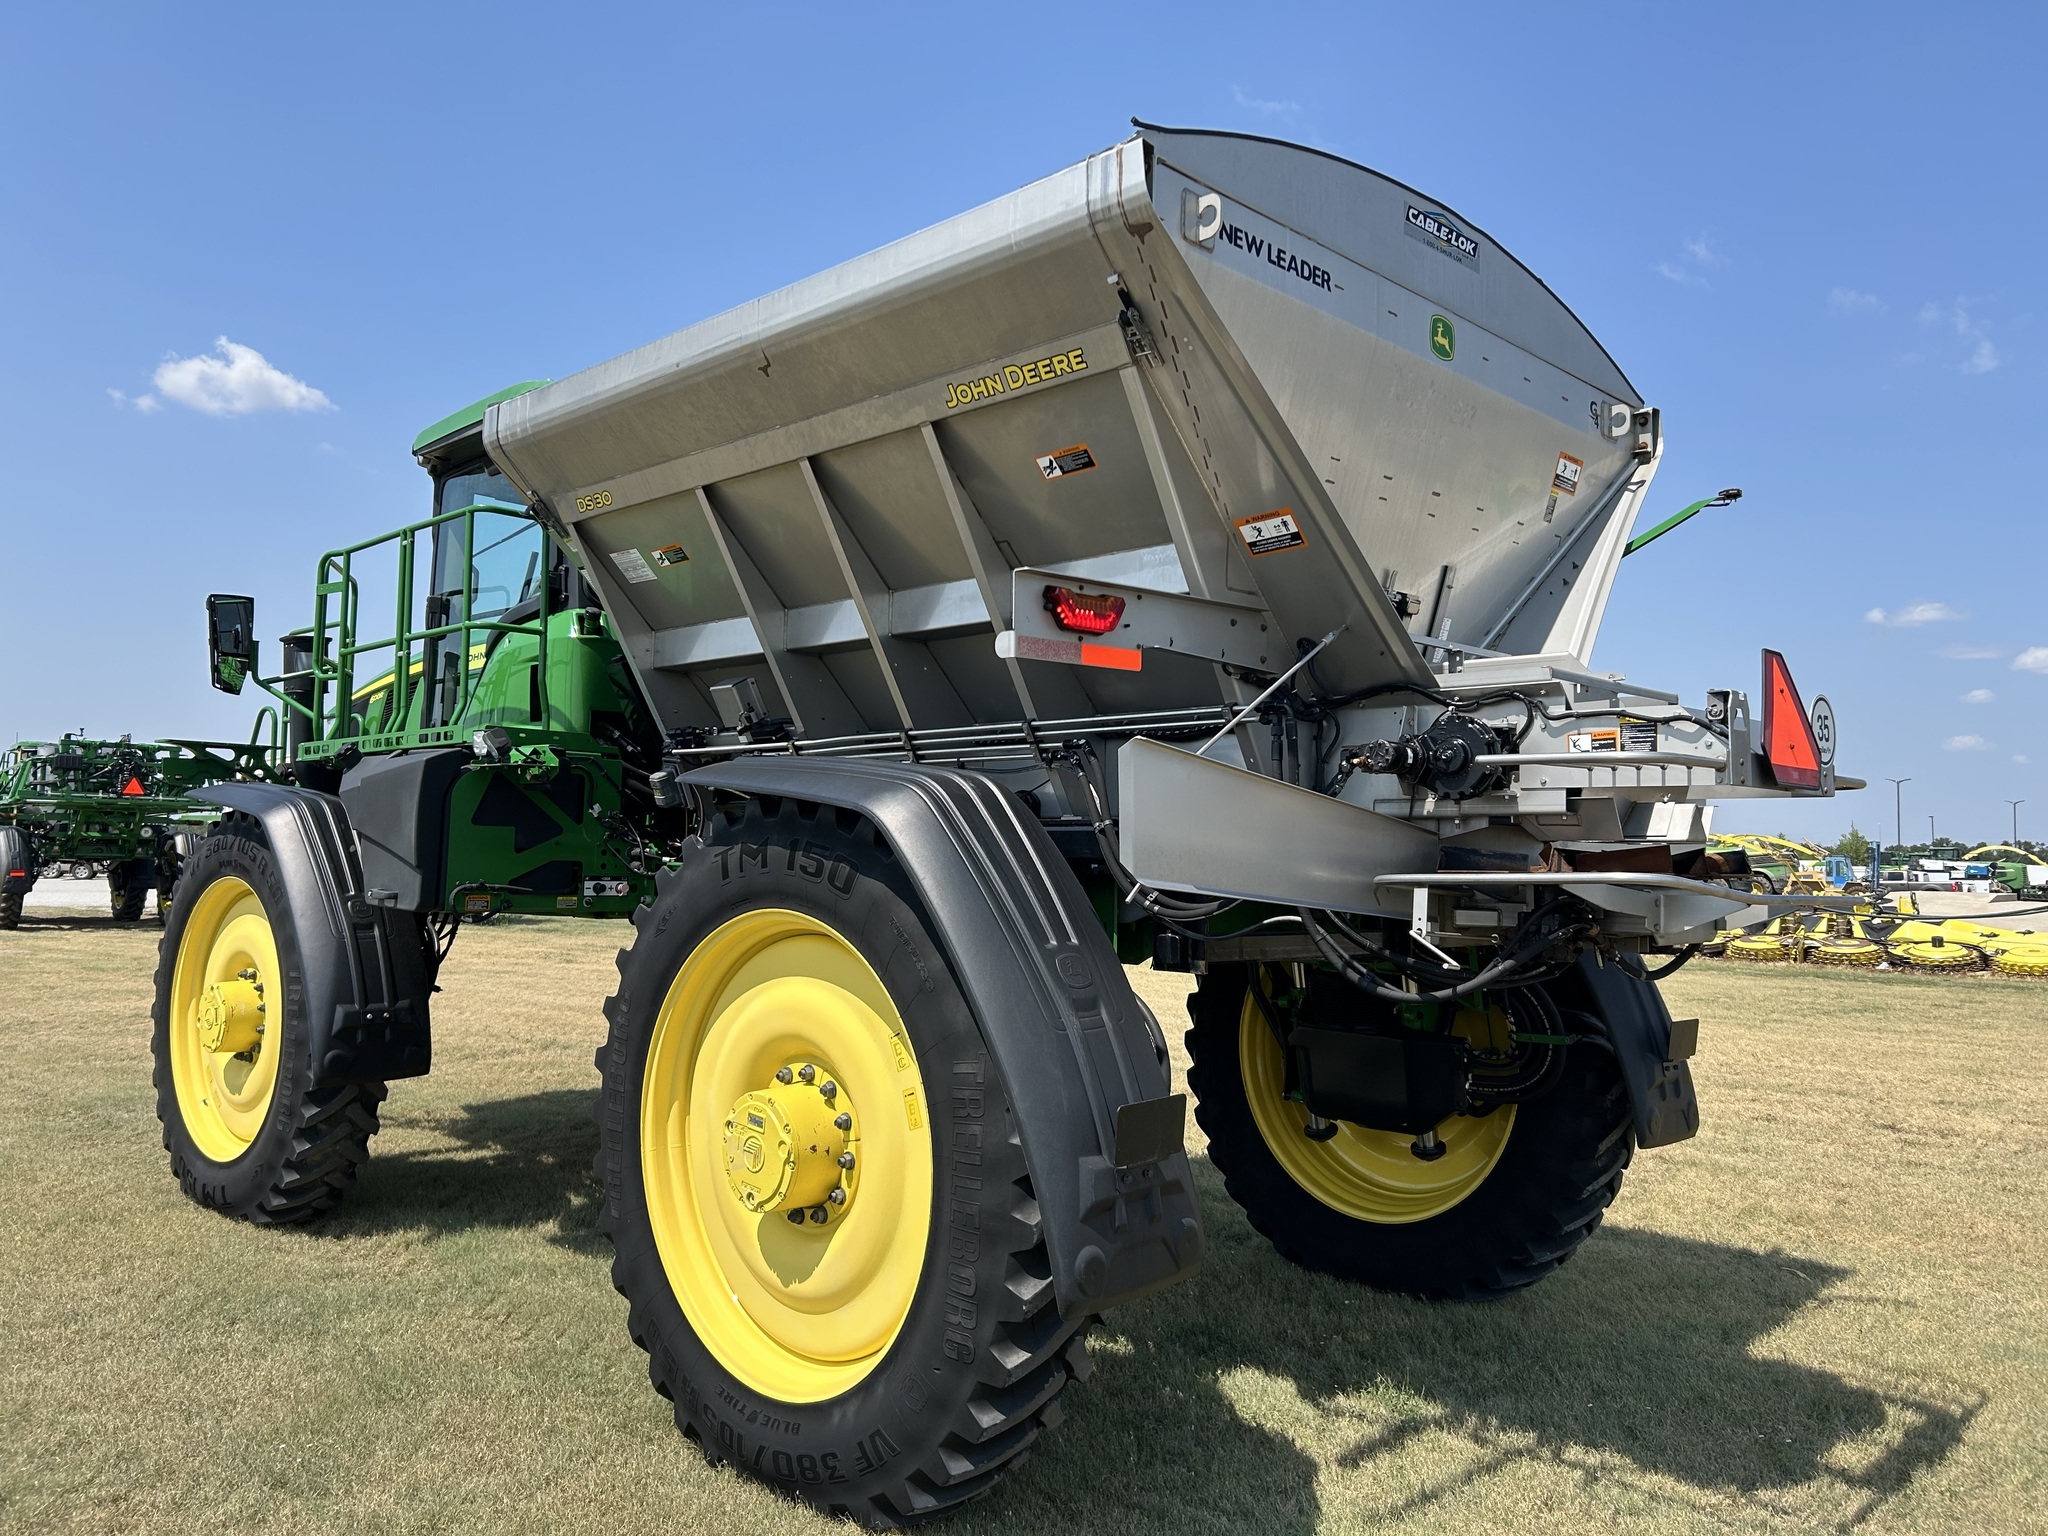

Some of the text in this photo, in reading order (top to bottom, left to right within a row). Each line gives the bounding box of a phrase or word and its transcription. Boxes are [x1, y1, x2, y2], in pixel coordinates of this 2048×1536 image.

[1219, 221, 1332, 293] NEW LEADER
[1817, 714, 1830, 743] 35
[205, 835, 260, 863] 380/105
[713, 835, 861, 900] TM 150
[943, 1050, 988, 1366] TRELLEBORG
[714, 1383, 802, 1437] BLUE TIRE
[700, 1402, 849, 1486] 380/105
[853, 1425, 902, 1477] VF
